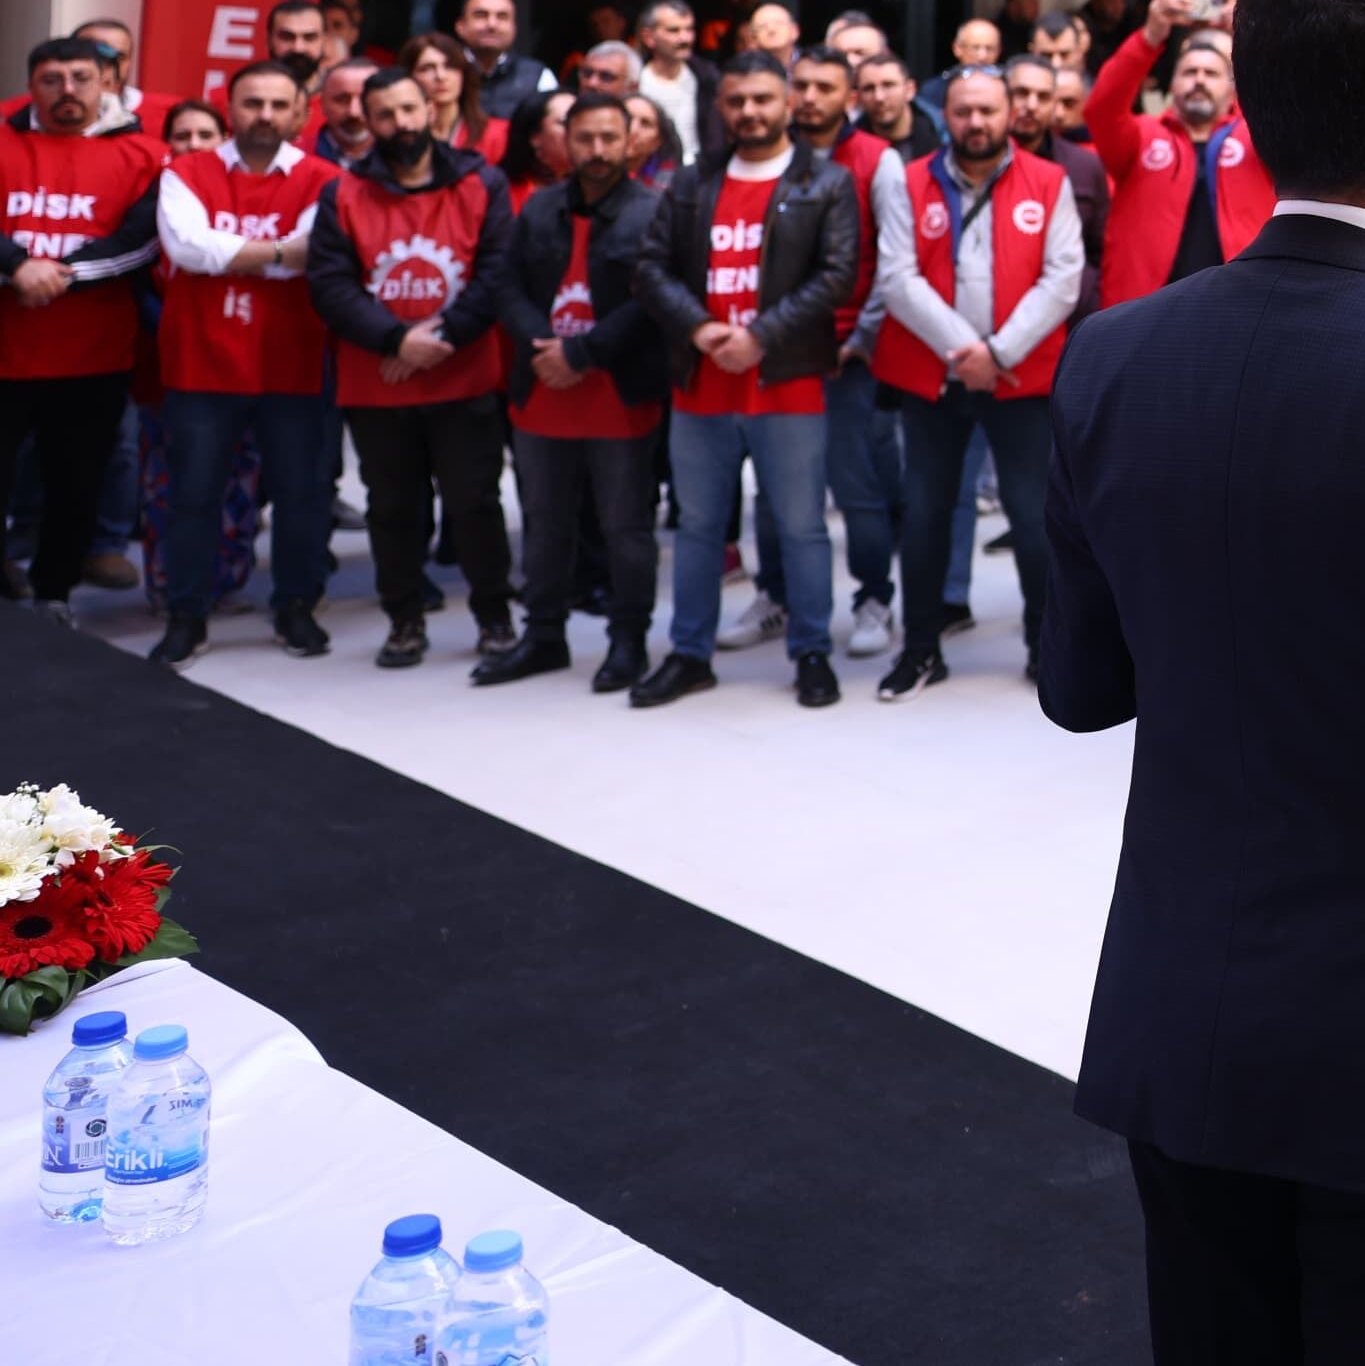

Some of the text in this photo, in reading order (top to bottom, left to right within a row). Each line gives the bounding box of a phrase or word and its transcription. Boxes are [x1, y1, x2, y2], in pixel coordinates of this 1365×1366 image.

[7, 186, 97, 221] DİSK
[381, 270, 444, 301] DİSK
[105, 1145, 164, 1171] Erikli
